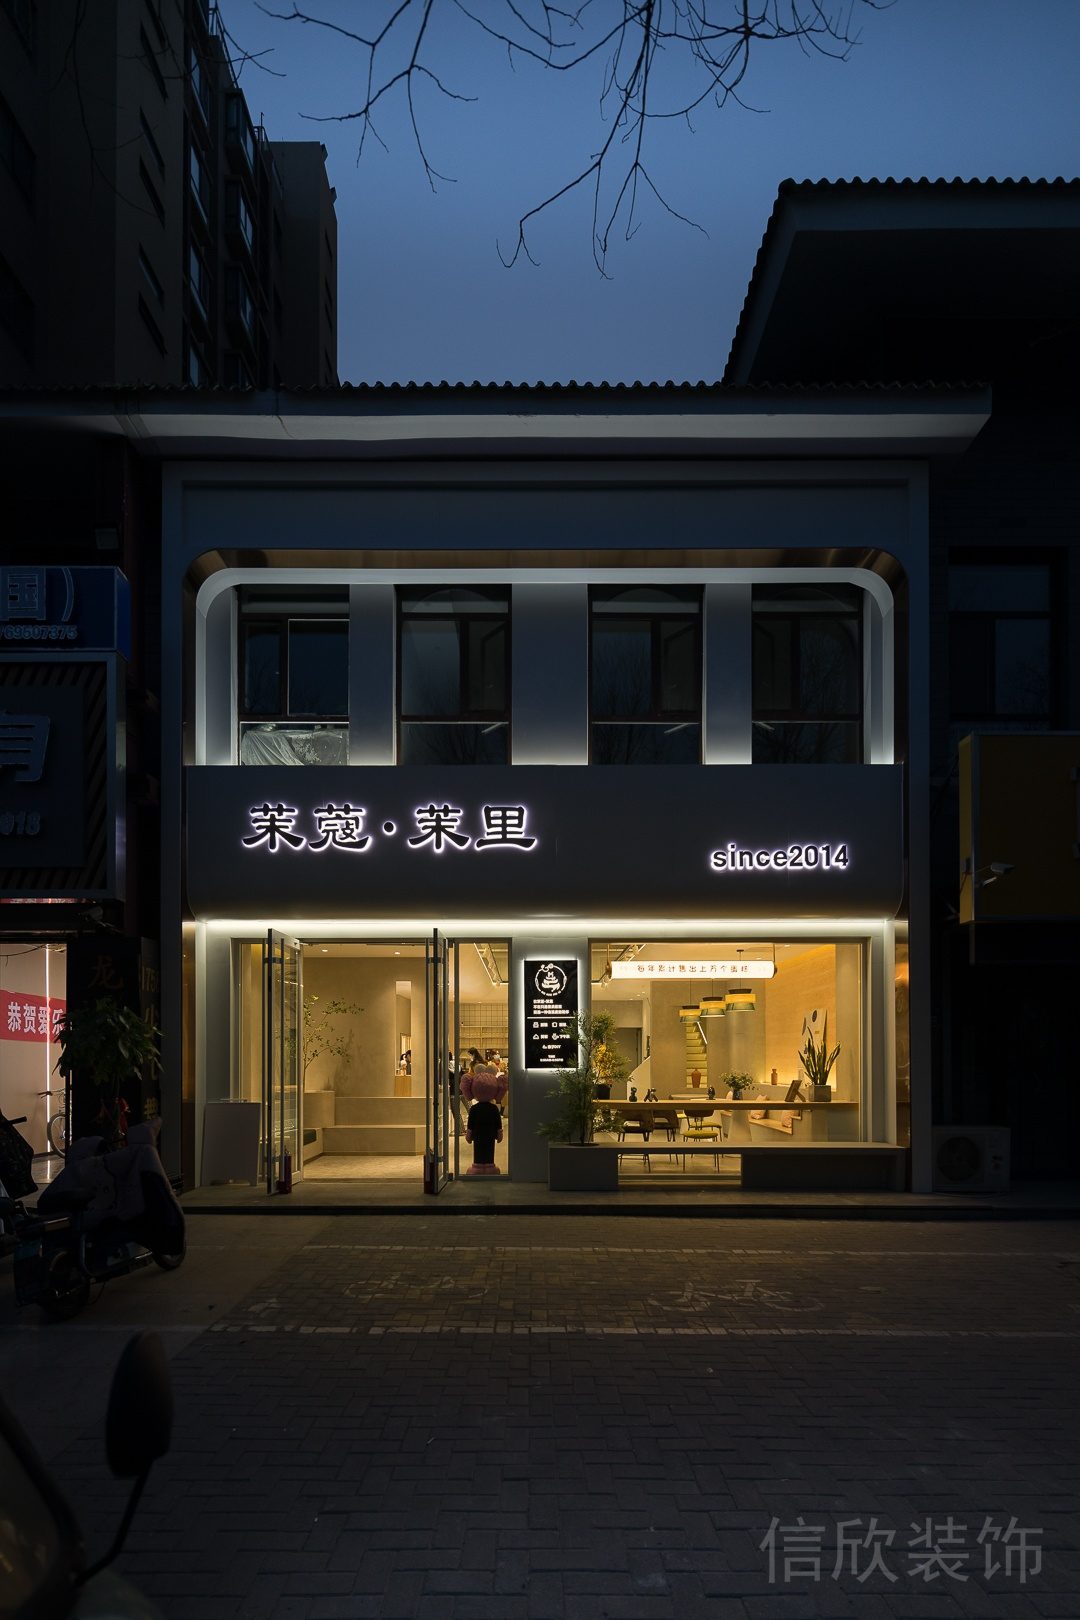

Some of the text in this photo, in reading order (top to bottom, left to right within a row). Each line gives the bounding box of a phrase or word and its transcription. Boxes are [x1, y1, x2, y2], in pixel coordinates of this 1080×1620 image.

[241, 803, 538, 852] 茉蔻·茉里
[710, 842, 850, 870] since2014
